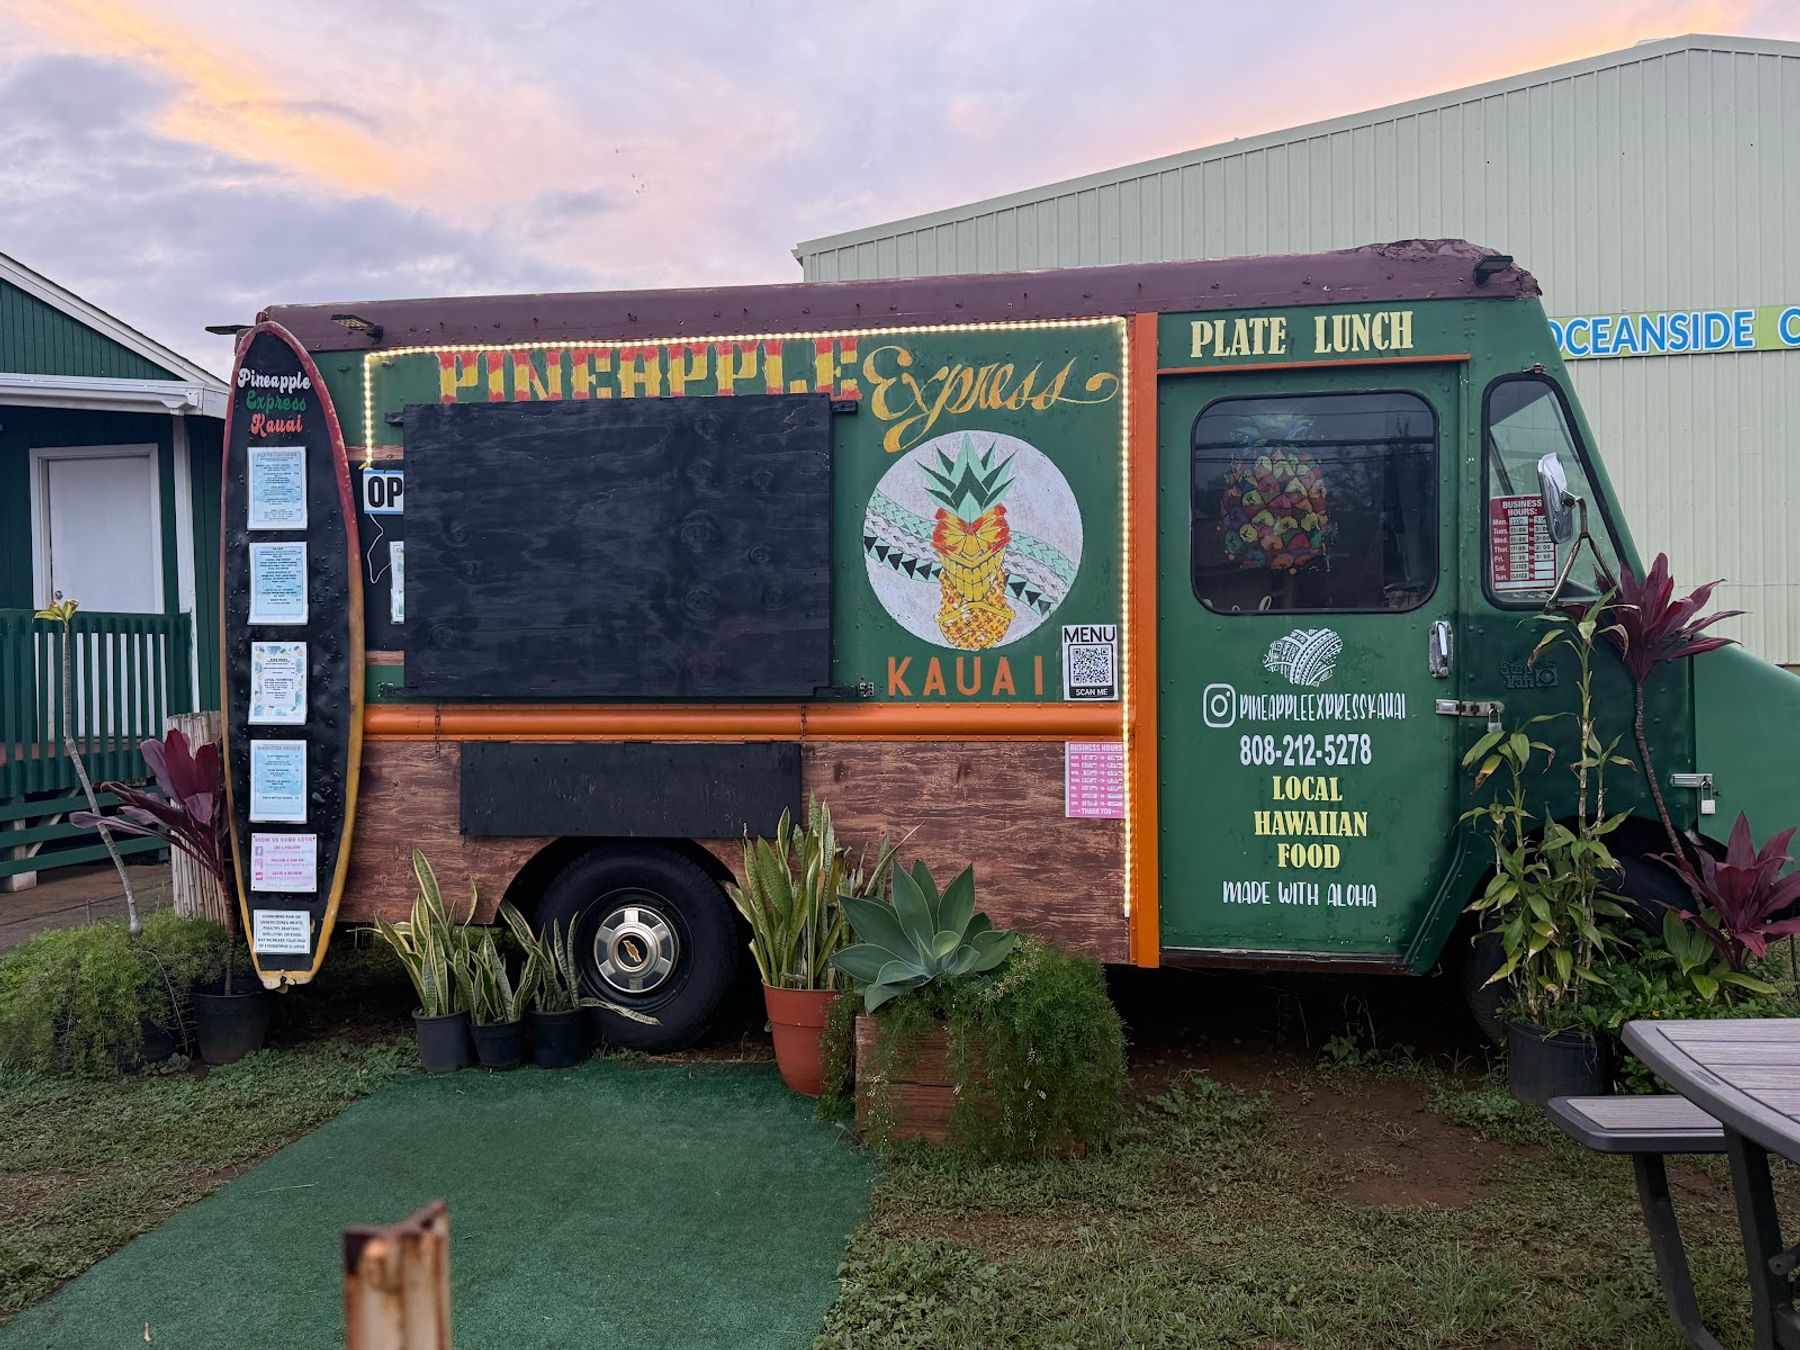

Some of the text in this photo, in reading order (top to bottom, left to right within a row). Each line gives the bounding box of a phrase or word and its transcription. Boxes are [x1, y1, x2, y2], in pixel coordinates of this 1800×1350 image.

[1190, 310, 1414, 358] PLATE LUNCH
[237, 368, 312, 393] Pineapple
[436, 336, 863, 404] PINEAPPLE
[246, 390, 307, 414] Express
[862, 346, 1120, 453] Express
[250, 413, 303, 437] Kauai
[1502, 499, 1542, 508] BUSINESS
[1507, 507, 1538, 516] HOURS:
[1064, 626, 1116, 643] MENU
[887, 655, 1044, 697] KAUAI
[1075, 688, 1108, 696] SCAN ME
[1239, 692, 1406, 721] PINEAPPLEEXPRESSKAUAI
[1069, 743, 1123, 752] BUSINESS HOURS
[1240, 733, 1372, 766] 808-212-5278
[1272, 775, 1343, 801] LOCAL
[1253, 811, 1368, 837] HAWAIIAN
[1277, 843, 1341, 869] FOOD
[1223, 880, 1377, 908] MADE WITH ALOHA
